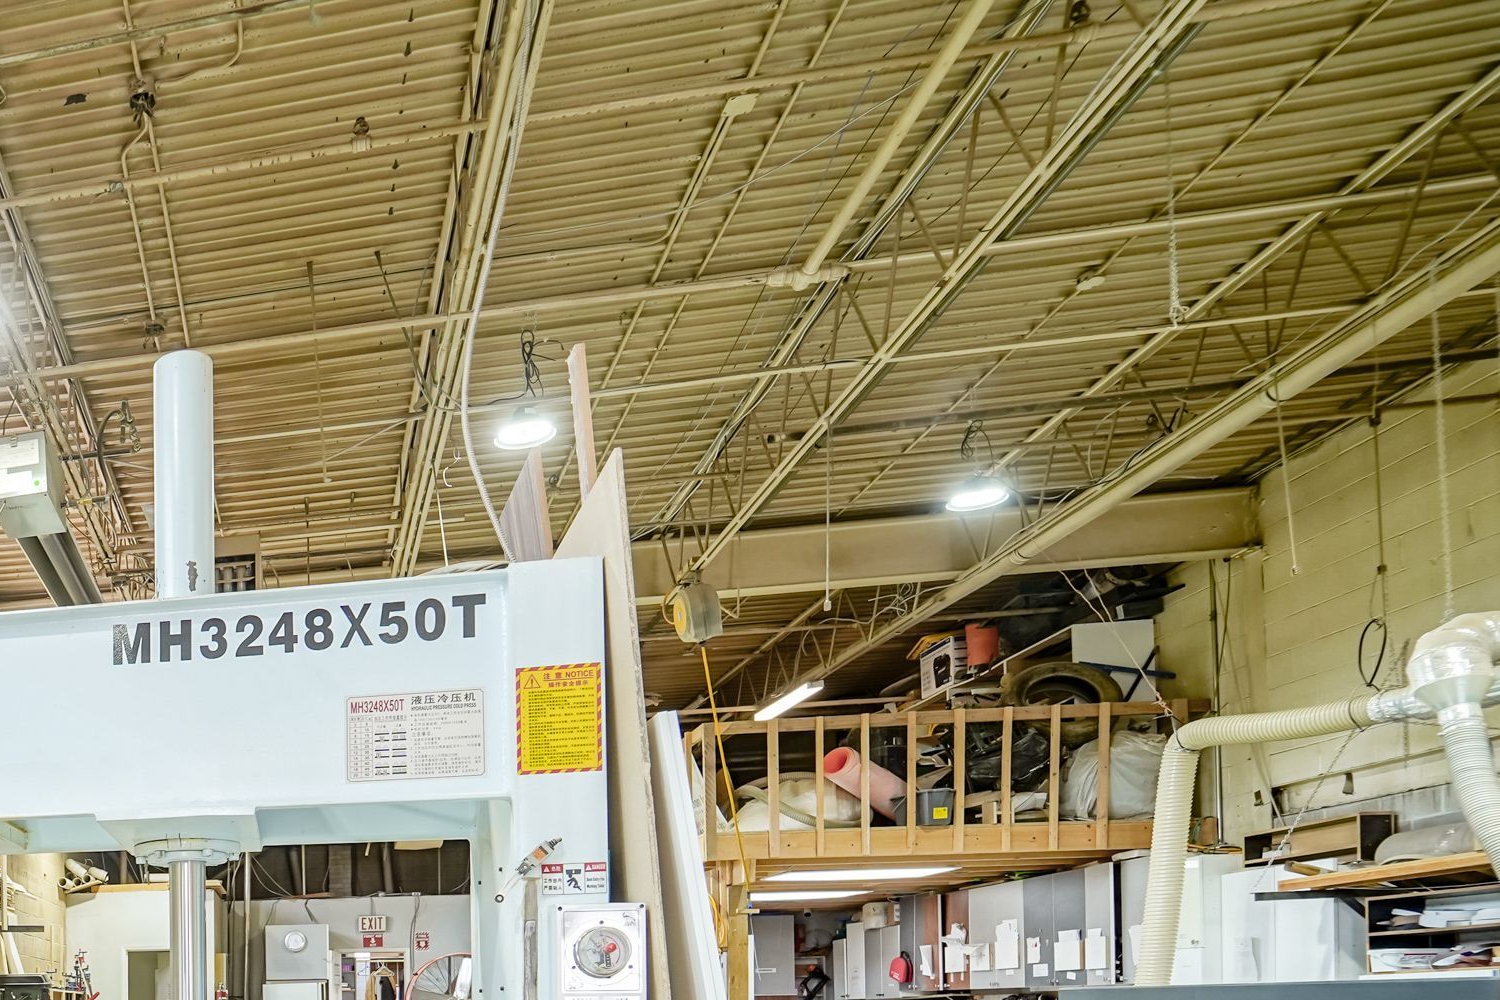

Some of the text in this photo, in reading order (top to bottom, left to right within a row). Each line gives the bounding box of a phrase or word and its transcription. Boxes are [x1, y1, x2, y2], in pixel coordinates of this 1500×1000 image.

[112, 593, 487, 666] MH3248X50T
[565, 669, 594, 678] NOTICE
[411, 692, 476, 705] 液压冷压机
[350, 698, 405, 714] MH3248X50T
[361, 917, 383, 931] EXIT
